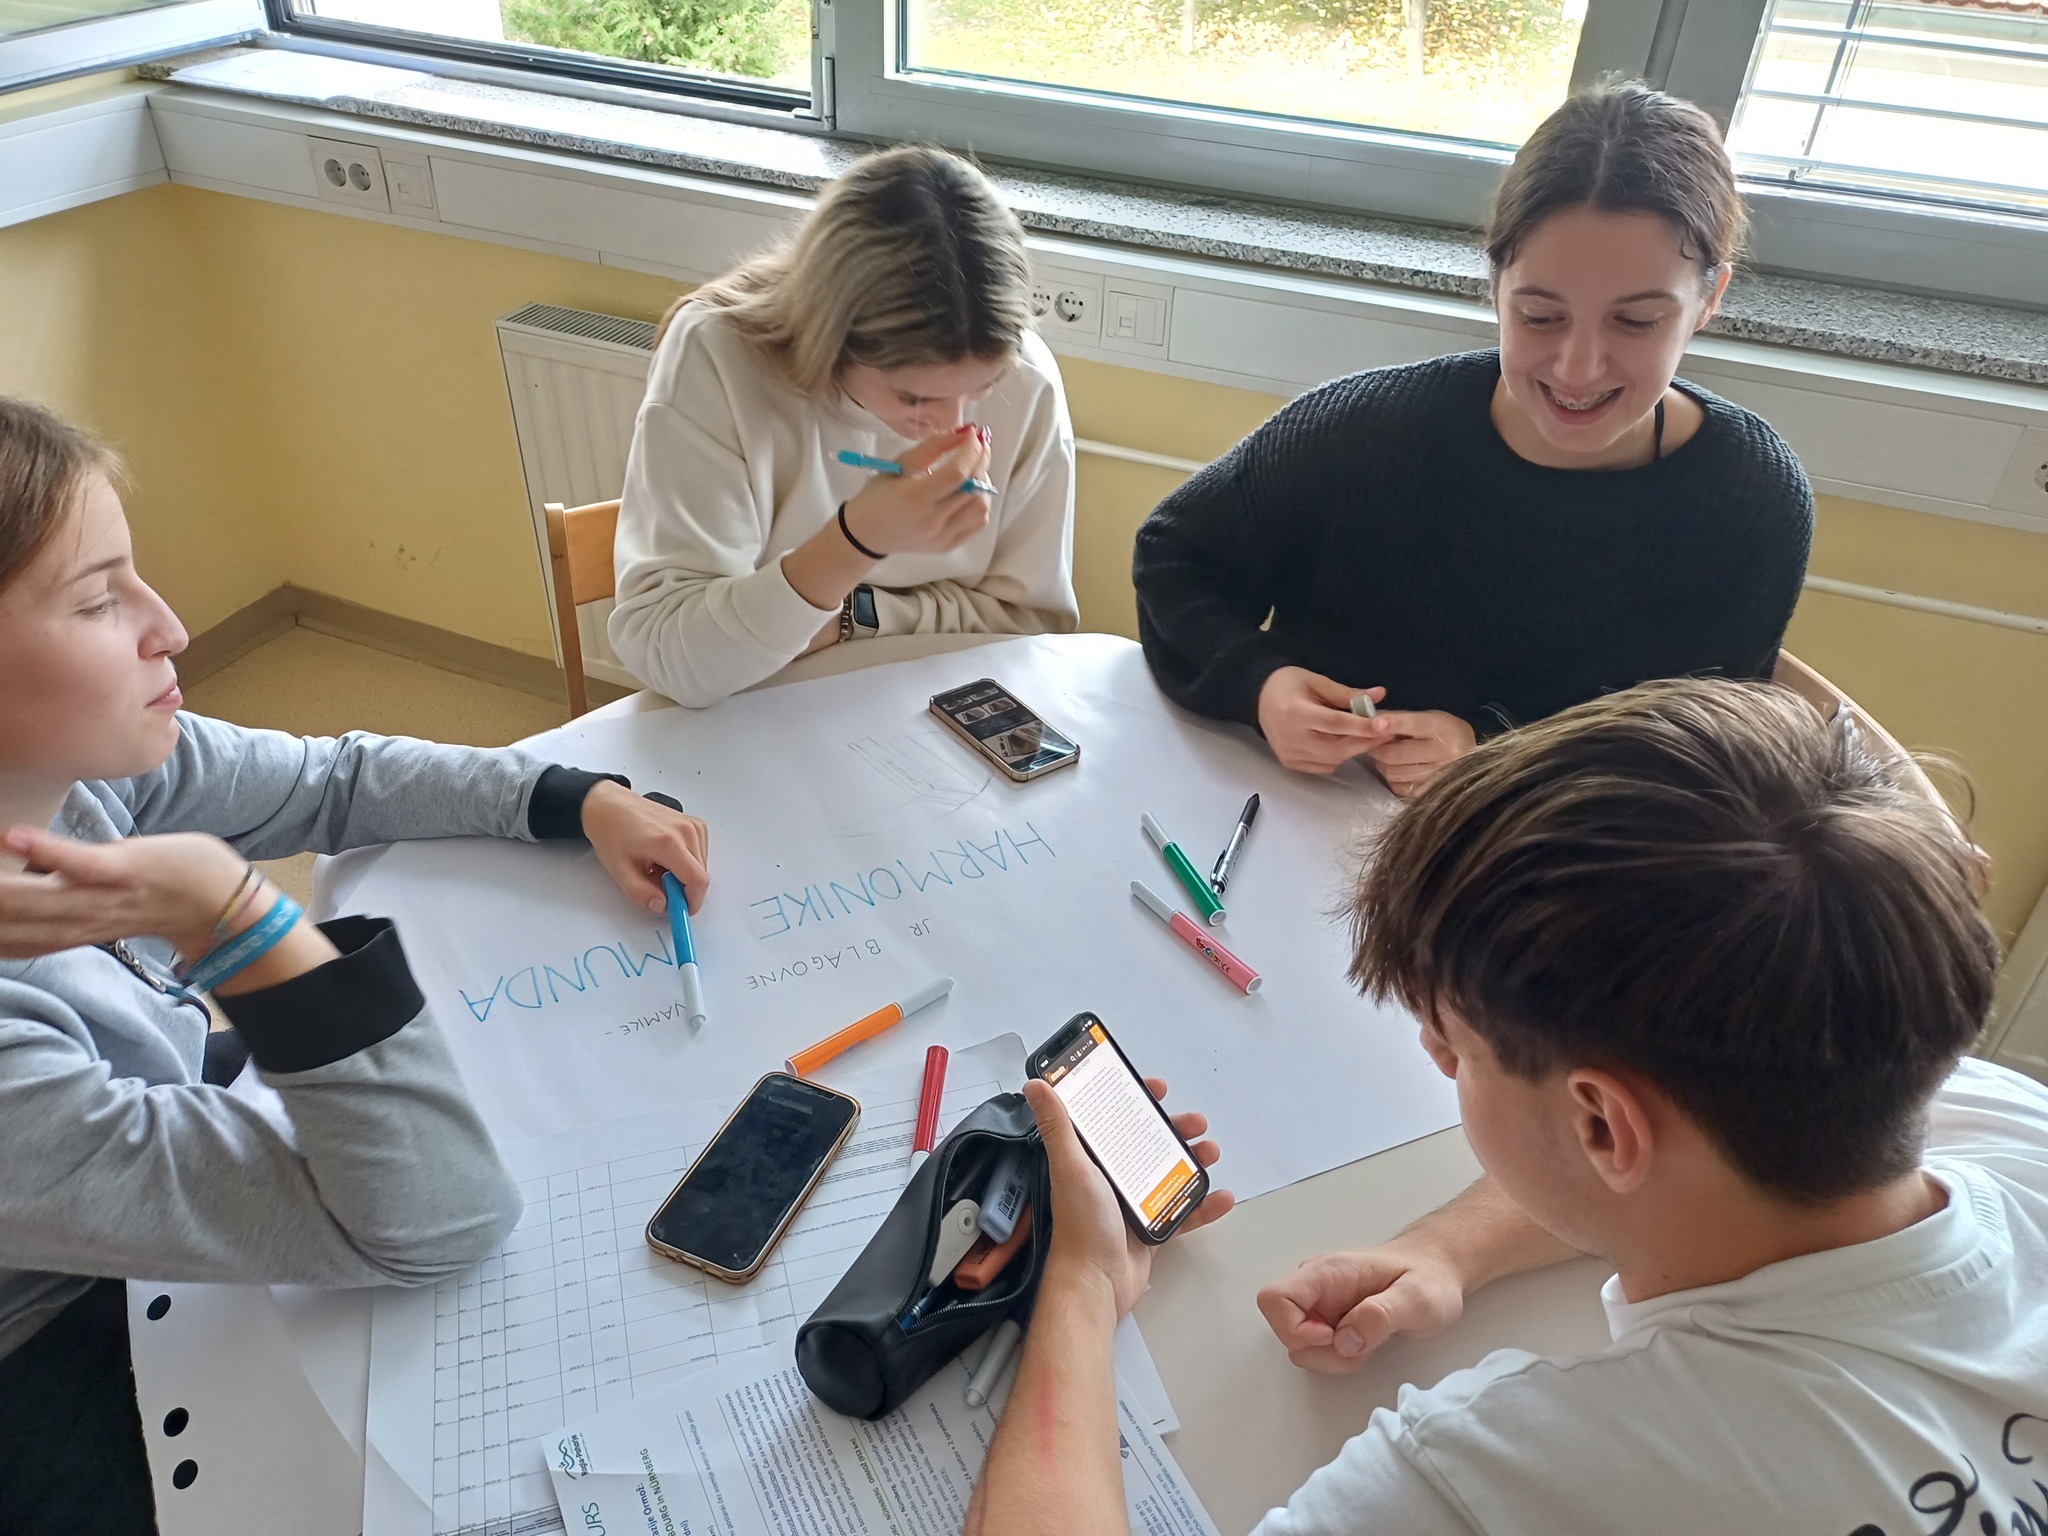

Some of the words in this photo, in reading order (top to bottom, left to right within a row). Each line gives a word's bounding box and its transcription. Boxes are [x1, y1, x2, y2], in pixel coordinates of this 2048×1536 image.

[750, 820, 1057, 940] HARMONIKE
[746, 938, 883, 991] BLAGOVNE
[457, 929, 675, 1023] MUNDA
[762, 1378, 770, 1389] cest
[782, 1370, 798, 1398] prepredajo
[791, 1367, 802, 1386] Nočitev
[743, 1386, 751, 1396] leta
[748, 1396, 754, 1404] od
[753, 1382, 764, 1401] Nemški
[774, 1378, 791, 1409] Sredozemlje
[725, 1393, 743, 1428] predstavitvah
[761, 1401, 771, 1418] Ludvik
[776, 1407, 788, 1427] pomeni
[759, 1420, 771, 1441] pomena
[769, 1418, 782, 1444] frankovski
[788, 1409, 804, 1438] povezovala
[928, 1402, 951, 1440] spremljevalca
[690, 1423, 701, 1444] Nemčije
[783, 1427, 791, 1438] ime
[863, 1426, 873, 1443] mesto
[906, 1424, 918, 1441] vožnja
[789, 1438, 801, 1461] katerega
[821, 1439, 829, 1448] tod
[826, 1448, 833, 1456] da
[850, 1438, 859, 1449] km)
[883, 1444, 893, 1461] Gradu
[894, 1445, 905, 1462] Glavni
[915, 1442, 924, 1454] sledi
[571, 1433, 588, 1476] Rogla-Pohorje
[761, 1457, 769, 1468] Čas
[768, 1442, 784, 1473] simbolnega
[780, 1445, 792, 1468] vzhodno
[816, 1449, 826, 1466] uličice
[871, 1443, 884, 1466] največje
[954, 1451, 968, 1472] dijakov
[640, 1448, 661, 1495] NÜRNBERG
[752, 1462, 767, 1491] sodelovali
[824, 1467, 832, 1480] ozke
[860, 1461, 874, 1484] ORMOŽ
[882, 1466, 893, 1483] drugo
[891, 1461, 901, 1477] mimo
[903, 1463, 911, 1475] tudi
[964, 1472, 971, 1481] 24
[708, 1471, 720, 1493] ozemlje
[780, 1473, 792, 1495] svojega
[792, 1475, 804, 1496] Plešasti
[813, 1471, 829, 1497] prometni
[837, 1469, 854, 1500] prepričanju
[909, 1476, 916, 1484] bo
[919, 1471, 933, 1496] Brunnen
[636, 1483, 652, 1515] Ormož:
[657, 1495, 665, 1504] in
[715, 1494, 723, 1504] čez
[764, 1491, 774, 1508] bomo
[806, 1481, 826, 1521] Kozmopolitsko
[914, 1486, 927, 1508] Zanimiv
[936, 1483, 949, 1502] prosto
[779, 1498, 790, 1518] centre
[788, 1495, 799, 1513] zaradi
[801, 1497, 810, 1512] Karel
[836, 1495, 846, 1514] lesene
[849, 1501, 864, 1526] botrovali
[873, 1487, 891, 1520] NÜRNBERG
[931, 1498, 945, 1521] Schöner
[946, 1503, 959, 1524] ogledu
[720, 1504, 733, 1529] postanki
[771, 1510, 779, 1520] kjer
[796, 1513, 808, 1536] amenta
[1143, 1517, 1151, 1526] 843
[647, 1516, 660, 1536] azije
